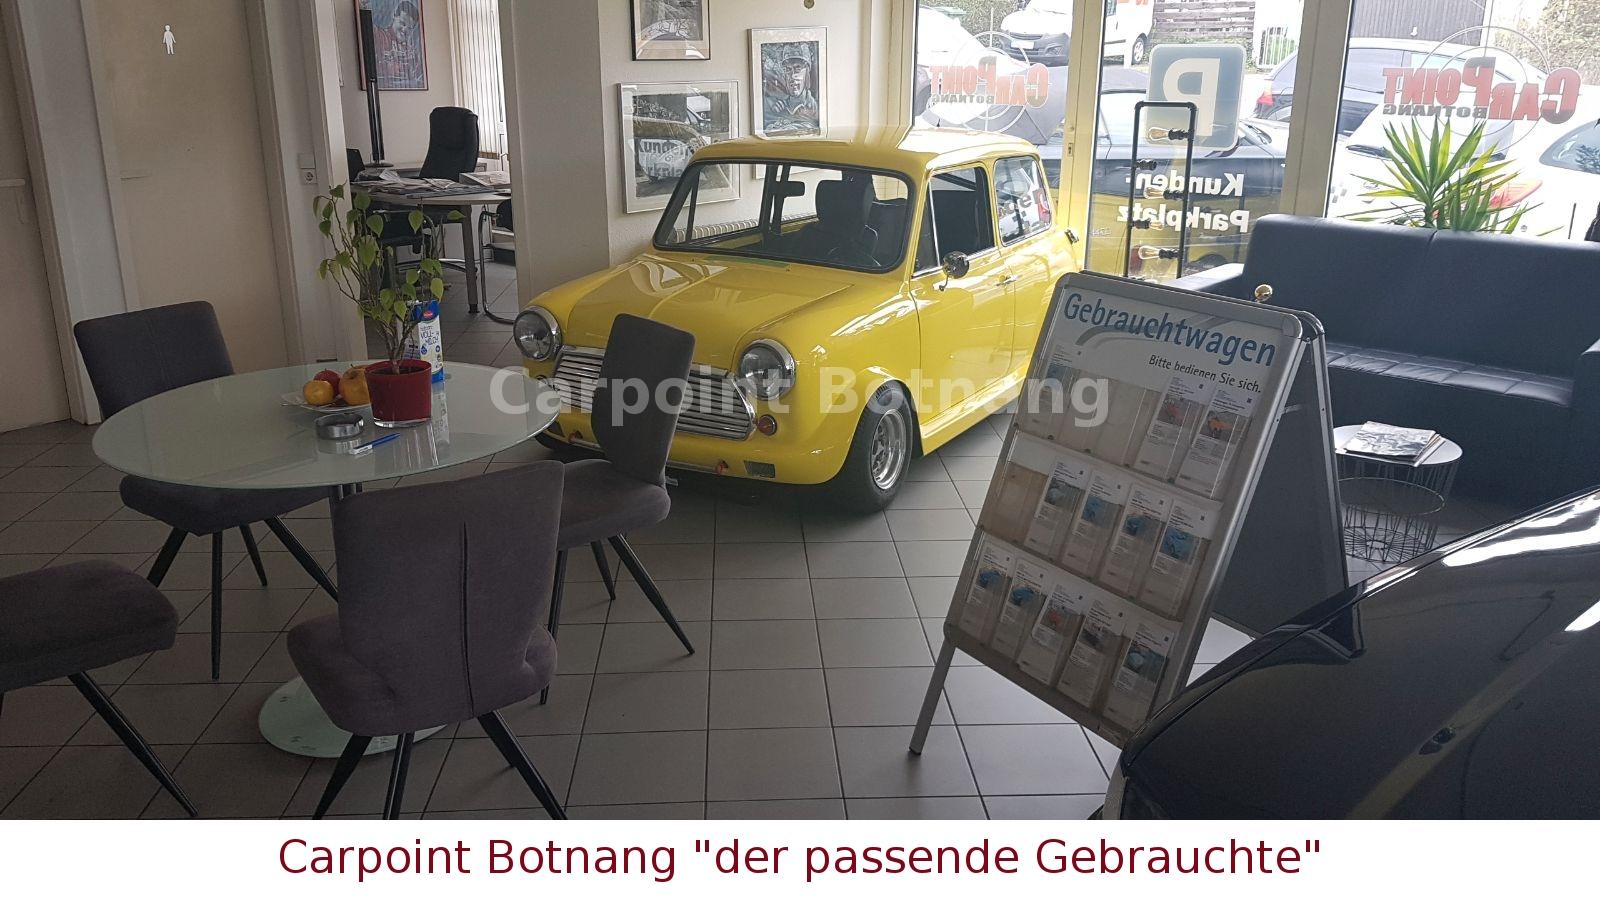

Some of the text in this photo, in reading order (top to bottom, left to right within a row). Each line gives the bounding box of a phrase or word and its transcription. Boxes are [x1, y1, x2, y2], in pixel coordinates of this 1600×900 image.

[1063, 292, 1276, 367] Gebrauchtwagen
[1148, 354, 1262, 393] Bitte bedienen Sie sich.
